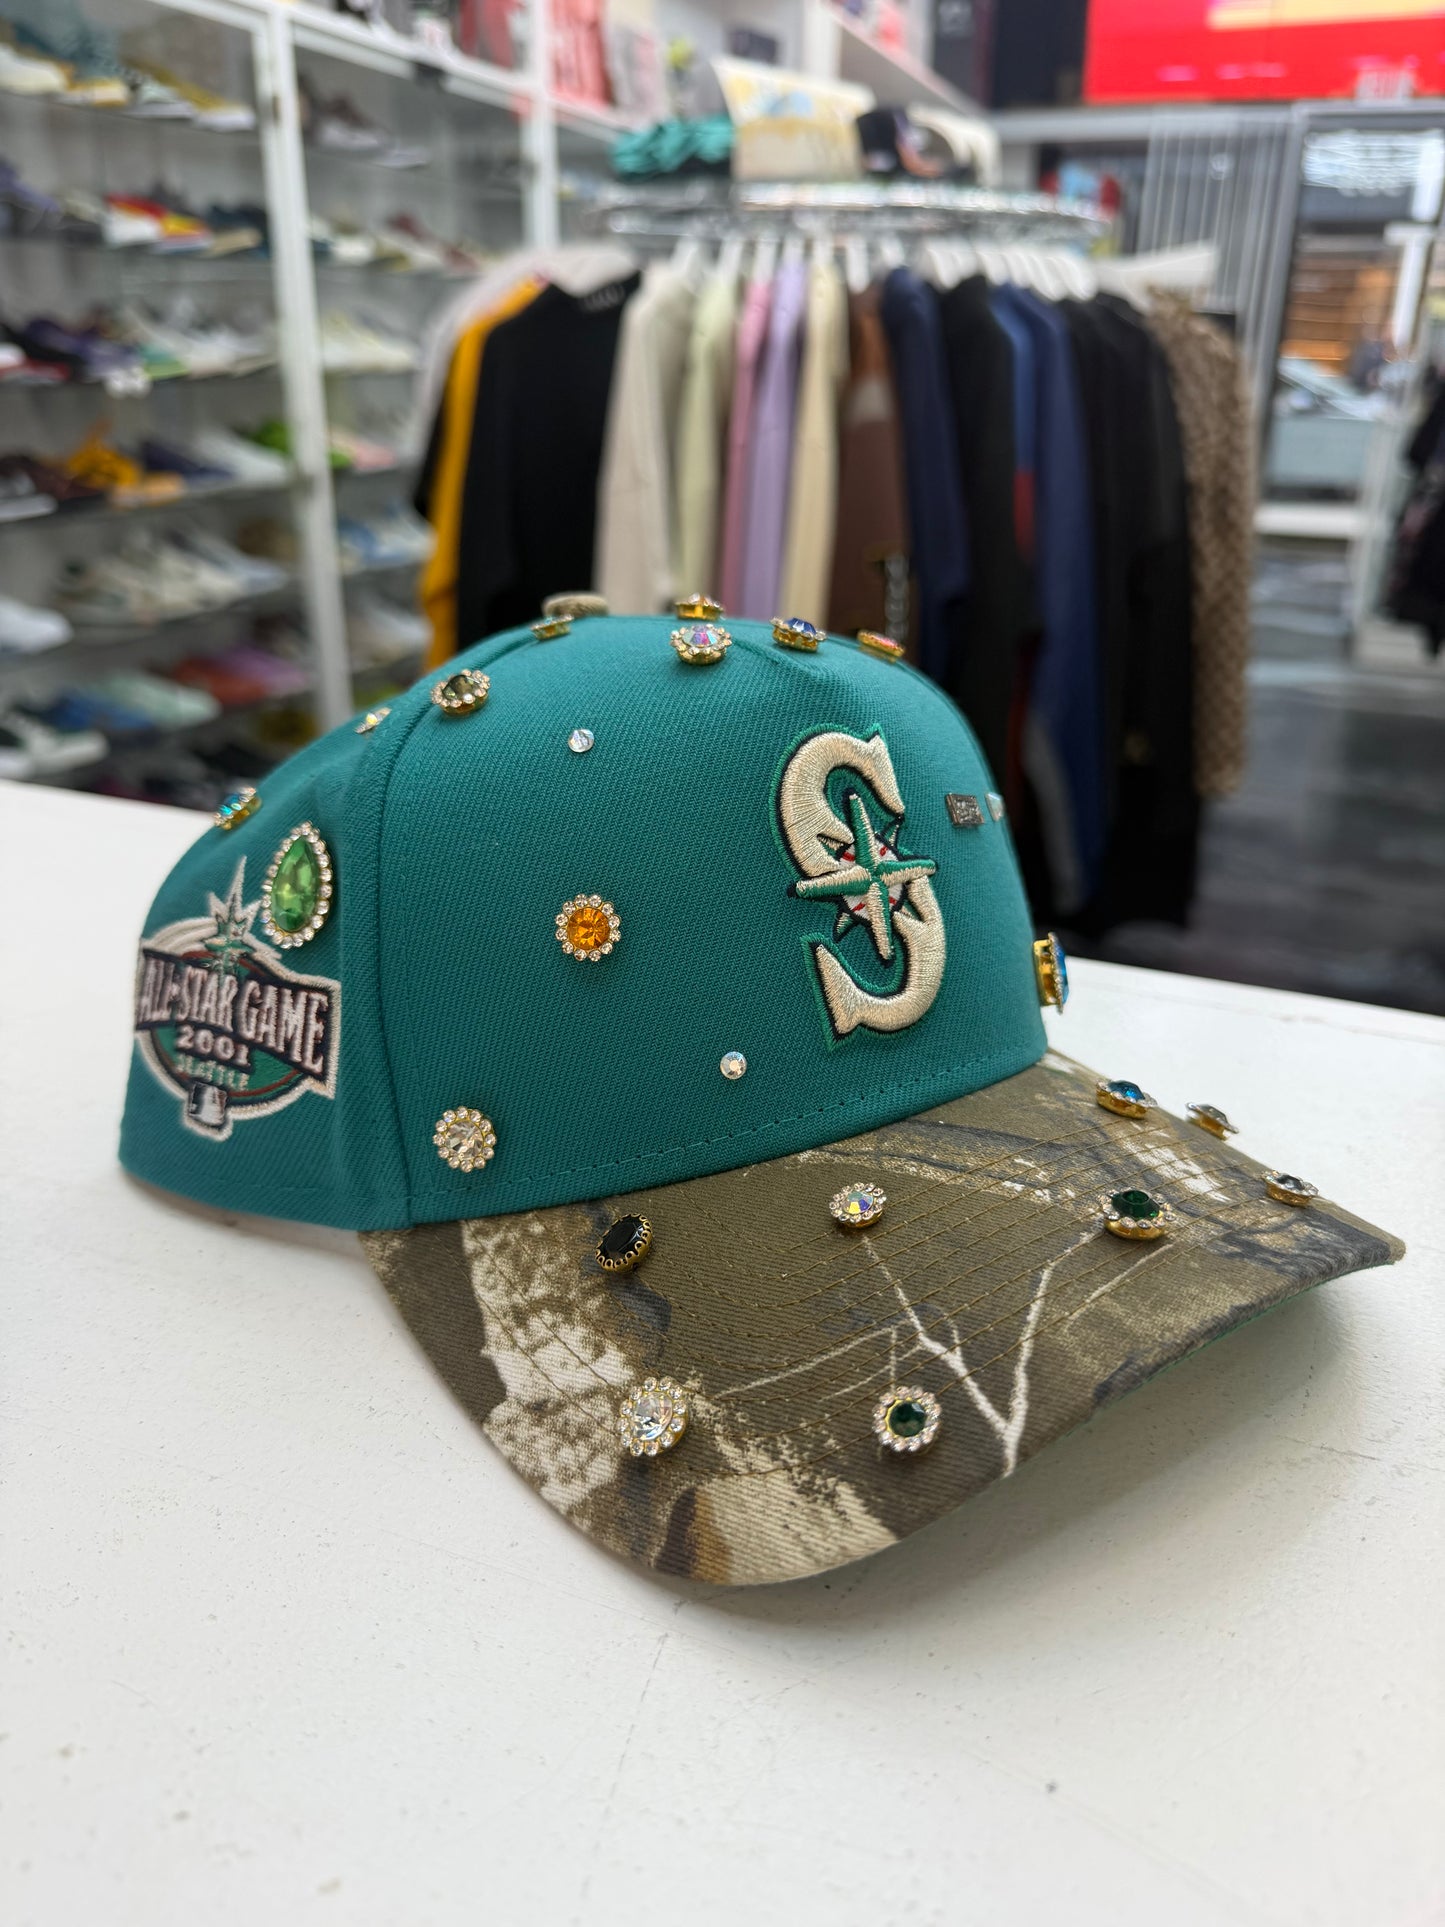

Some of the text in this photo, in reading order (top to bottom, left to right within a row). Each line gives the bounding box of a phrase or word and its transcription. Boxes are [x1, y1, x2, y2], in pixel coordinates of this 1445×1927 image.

[773, 726, 946, 1042] S
[176, 1024, 251, 1067] 2001
[239, 980, 328, 1073] GAME
